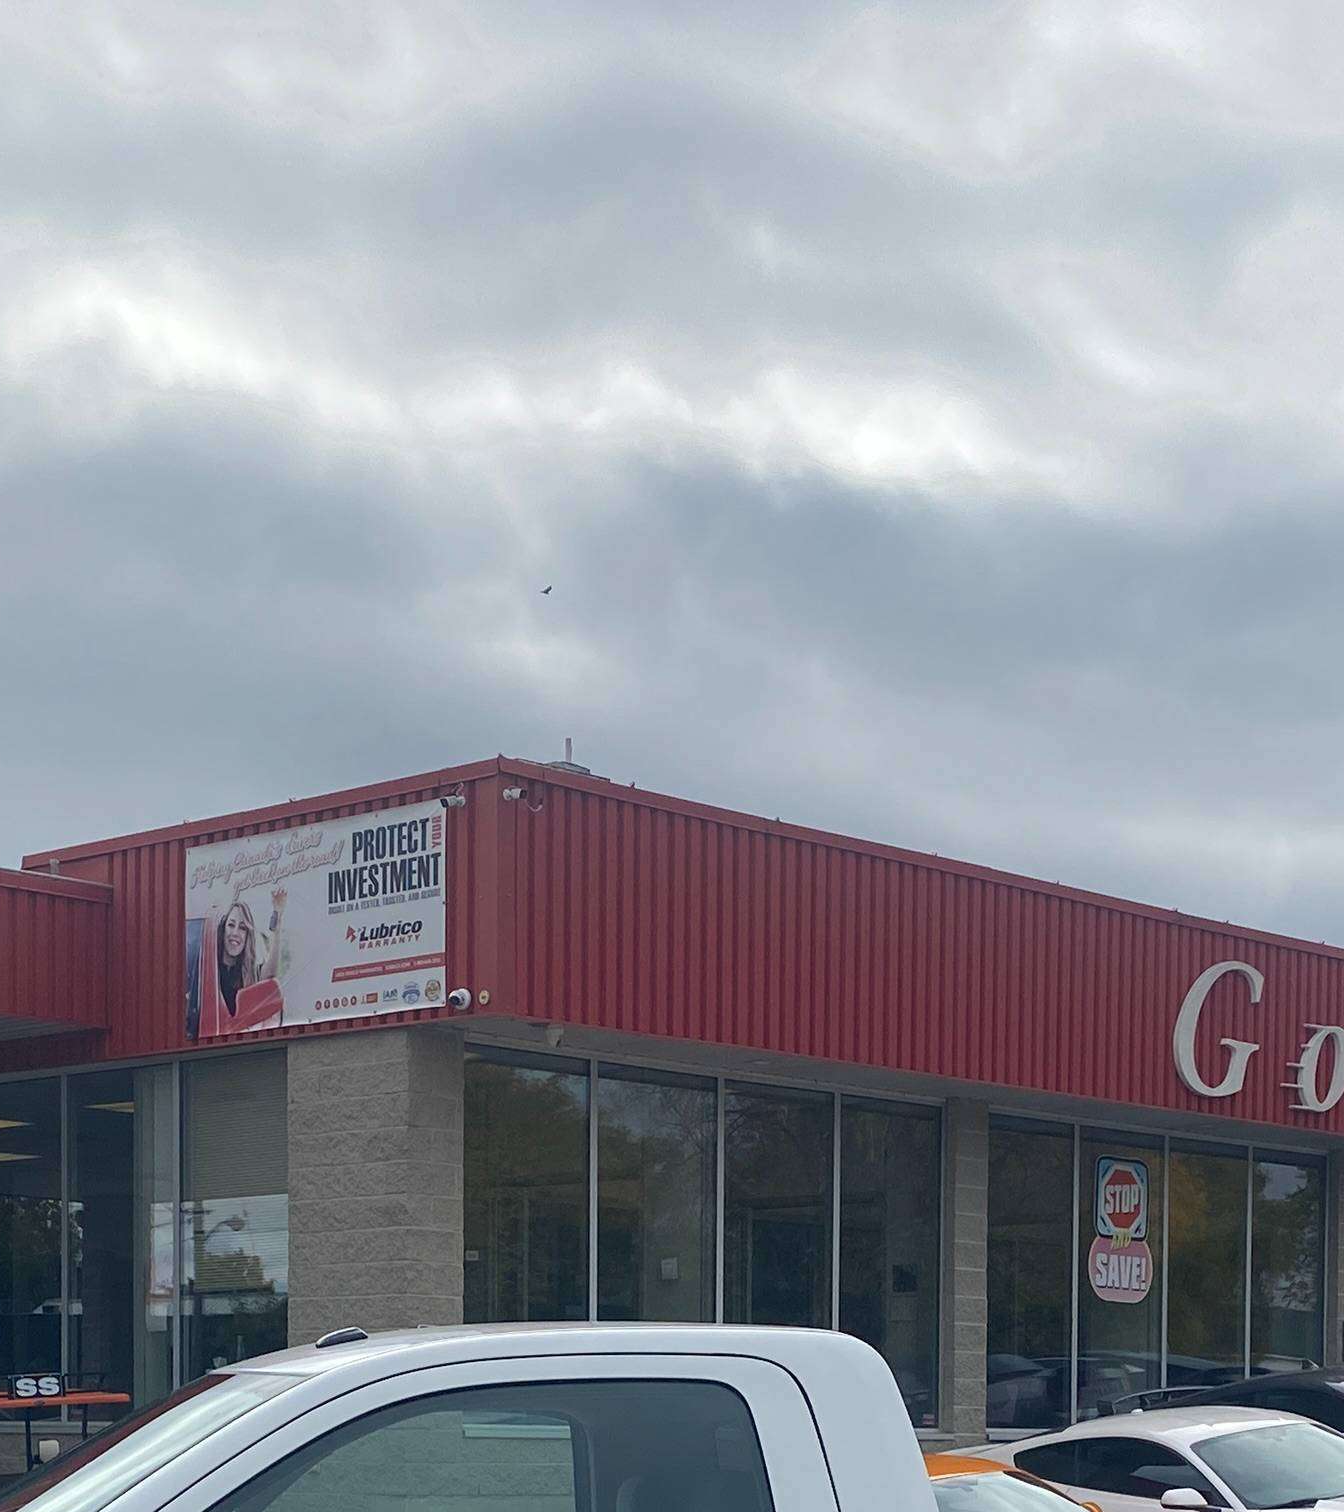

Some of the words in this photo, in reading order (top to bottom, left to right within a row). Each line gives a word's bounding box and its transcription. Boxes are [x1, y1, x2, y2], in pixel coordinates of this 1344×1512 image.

[352, 818, 429, 864] PROTECT
[432, 815, 441, 848] YOUR
[328, 852, 441, 904] INVESTMENT
[359, 920, 422, 942] Lubrico
[359, 934, 421, 950] WARRANTY
[1105, 1184, 1140, 1214] STOP
[1095, 1253, 1146, 1292] SAVE!
[16, 1377, 60, 1397] SS
